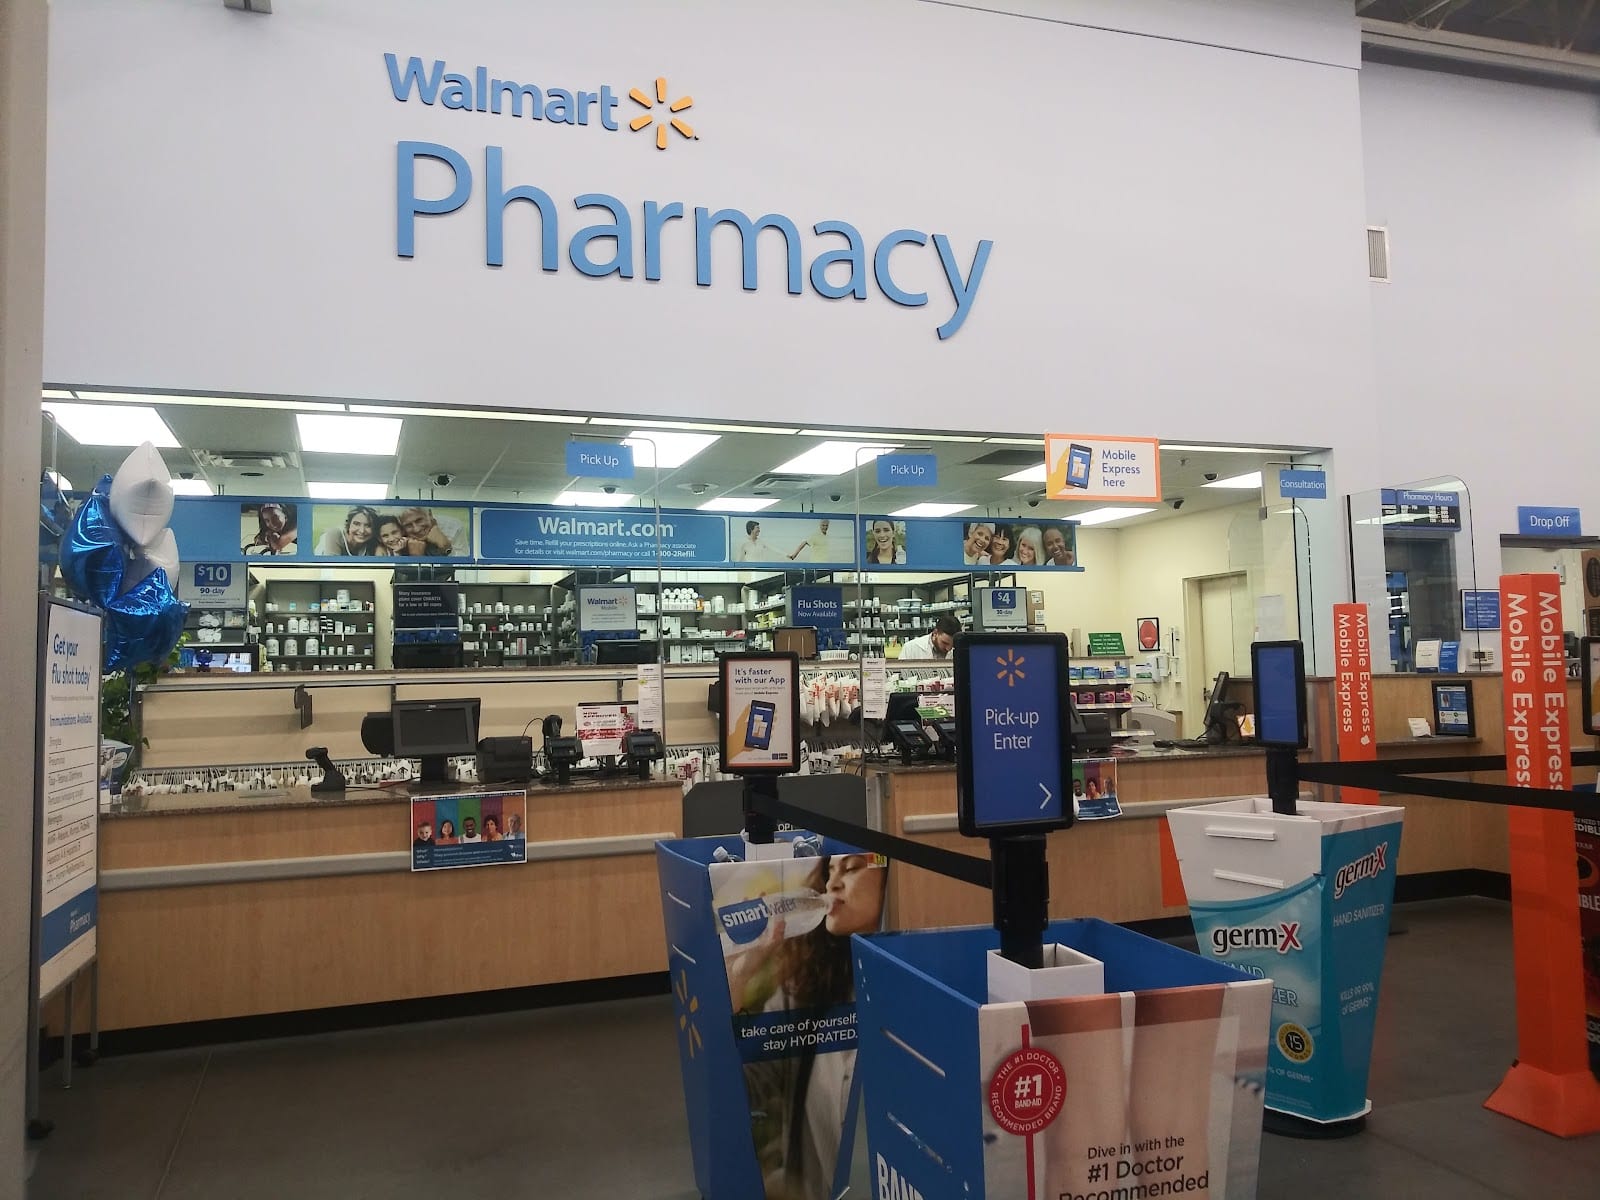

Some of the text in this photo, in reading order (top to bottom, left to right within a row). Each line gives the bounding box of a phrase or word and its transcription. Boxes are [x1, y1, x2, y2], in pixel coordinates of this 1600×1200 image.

[384, 52, 618, 131] Walmart
[397, 140, 993, 341] Pharmacy
[580, 453, 619, 468] Pick Up
[1102, 449, 1136, 460] Mobile
[890, 464, 924, 476] Pick Up
[1102, 462, 1140, 476] Express
[1102, 476, 1125, 487] here
[1280, 480, 1325, 488] Consultation
[1403, 491, 1453, 502] Pharmacy Hours
[538, 516, 674, 538] Walmart.com
[1530, 515, 1570, 530] Drop Off
[574, 540, 608, 548] prescriptions
[198, 565, 228, 580] $10
[798, 600, 838, 608] Flu Shots
[998, 592, 1010, 604] $4
[54, 634, 78, 661] Get your
[52, 663, 62, 684] flu
[62, 664, 74, 684] shot
[769, 677, 786, 685] App
[1338, 614, 1354, 732] Mobile Express
[1356, 613, 1370, 732] Mobile Express
[1508, 593, 1534, 788] Mobile Expres
[1538, 592, 1564, 790] Mobile Expres
[986, 707, 1039, 728] Pick-up
[994, 733, 1032, 750] Enter
[1334, 842, 1388, 899] germ-X
[722, 897, 797, 928] smartwater
[1333, 904, 1385, 927] HAND SANITIZER
[1212, 923, 1300, 953] germ-X
[742, 1012, 858, 1038] take care of yourself.
[763, 1028, 858, 1051] stay HYDRATED.
[1288, 1034, 1302, 1050] 15
[998, 1052, 1059, 1080] THE #1 DOCTOR
[1014, 1074, 1042, 1098] #1
[992, 1086, 1062, 1131] RECOMMENDED BRAND
[1088, 1136, 1184, 1160] Dive in with the
[1088, 1156, 1184, 1184] #1 Doctor
